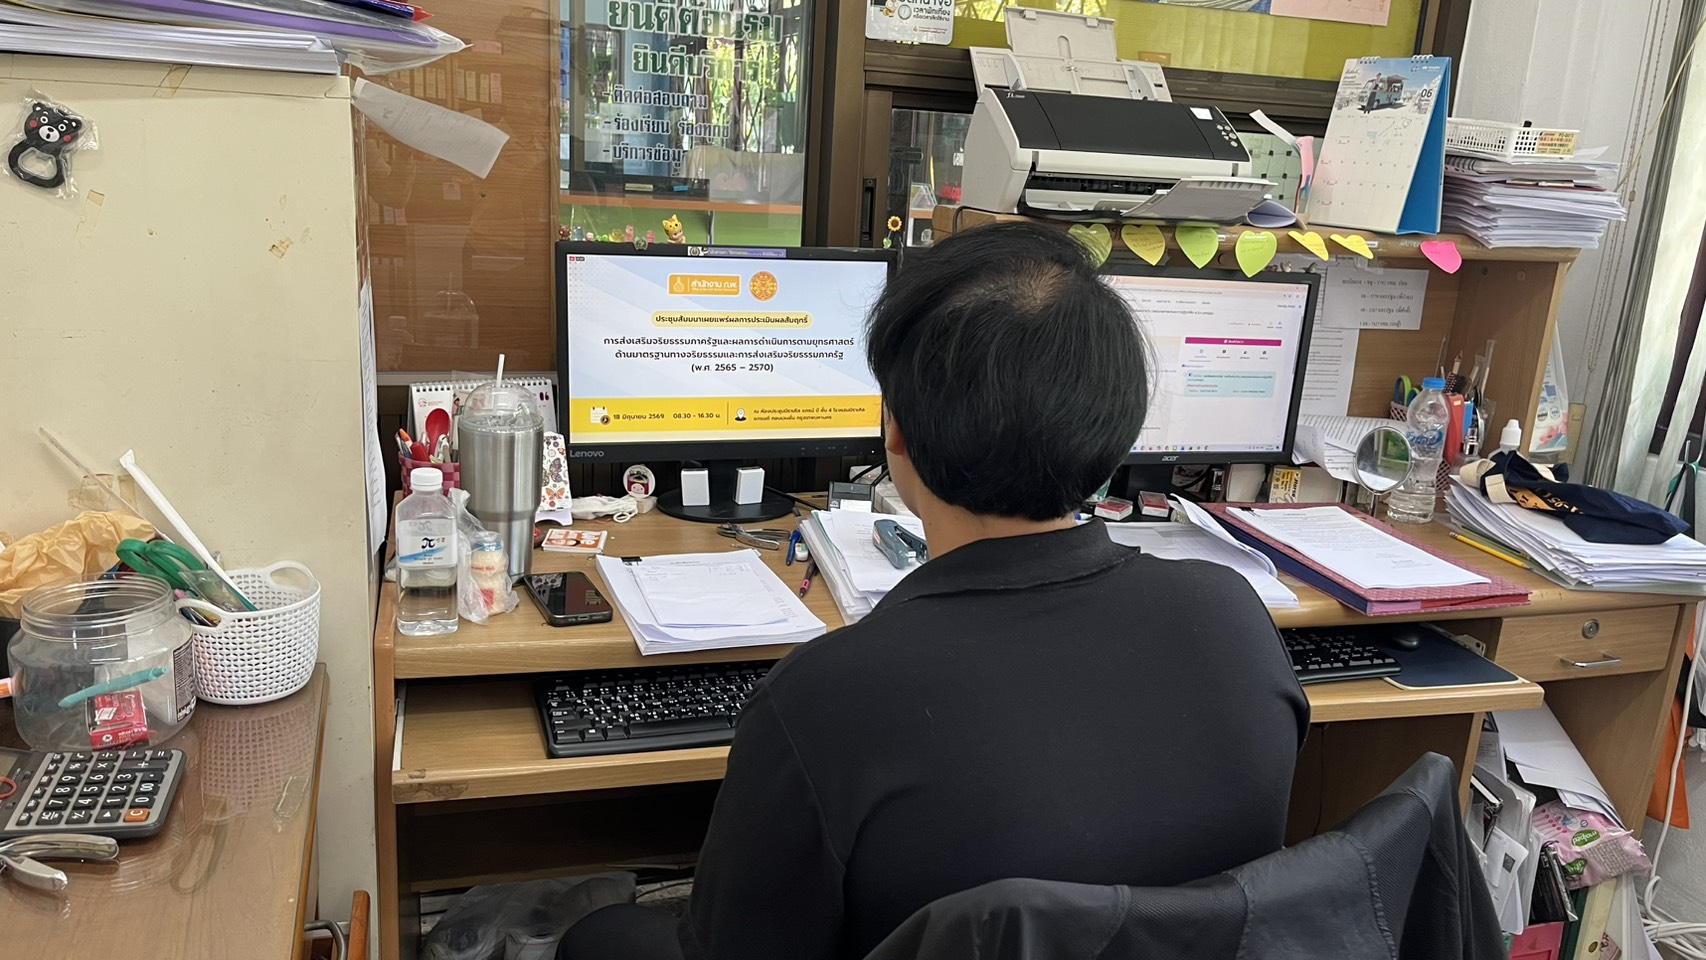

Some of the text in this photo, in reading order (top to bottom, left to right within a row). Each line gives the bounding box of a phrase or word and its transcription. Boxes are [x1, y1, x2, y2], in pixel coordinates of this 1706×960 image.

[1421, 88, 1433, 98] 06
[614, 113, 671, 134] ร้องเรียน
[615, 349, 844, 360] ด้านมาตรฐานทางจริยธรรมและการส่งเสริมจริยธรรมภาครัฐ
[714, 363, 737, 372] 2565
[748, 363, 774, 373] 2570)
[569, 449, 605, 458] Lenovo
